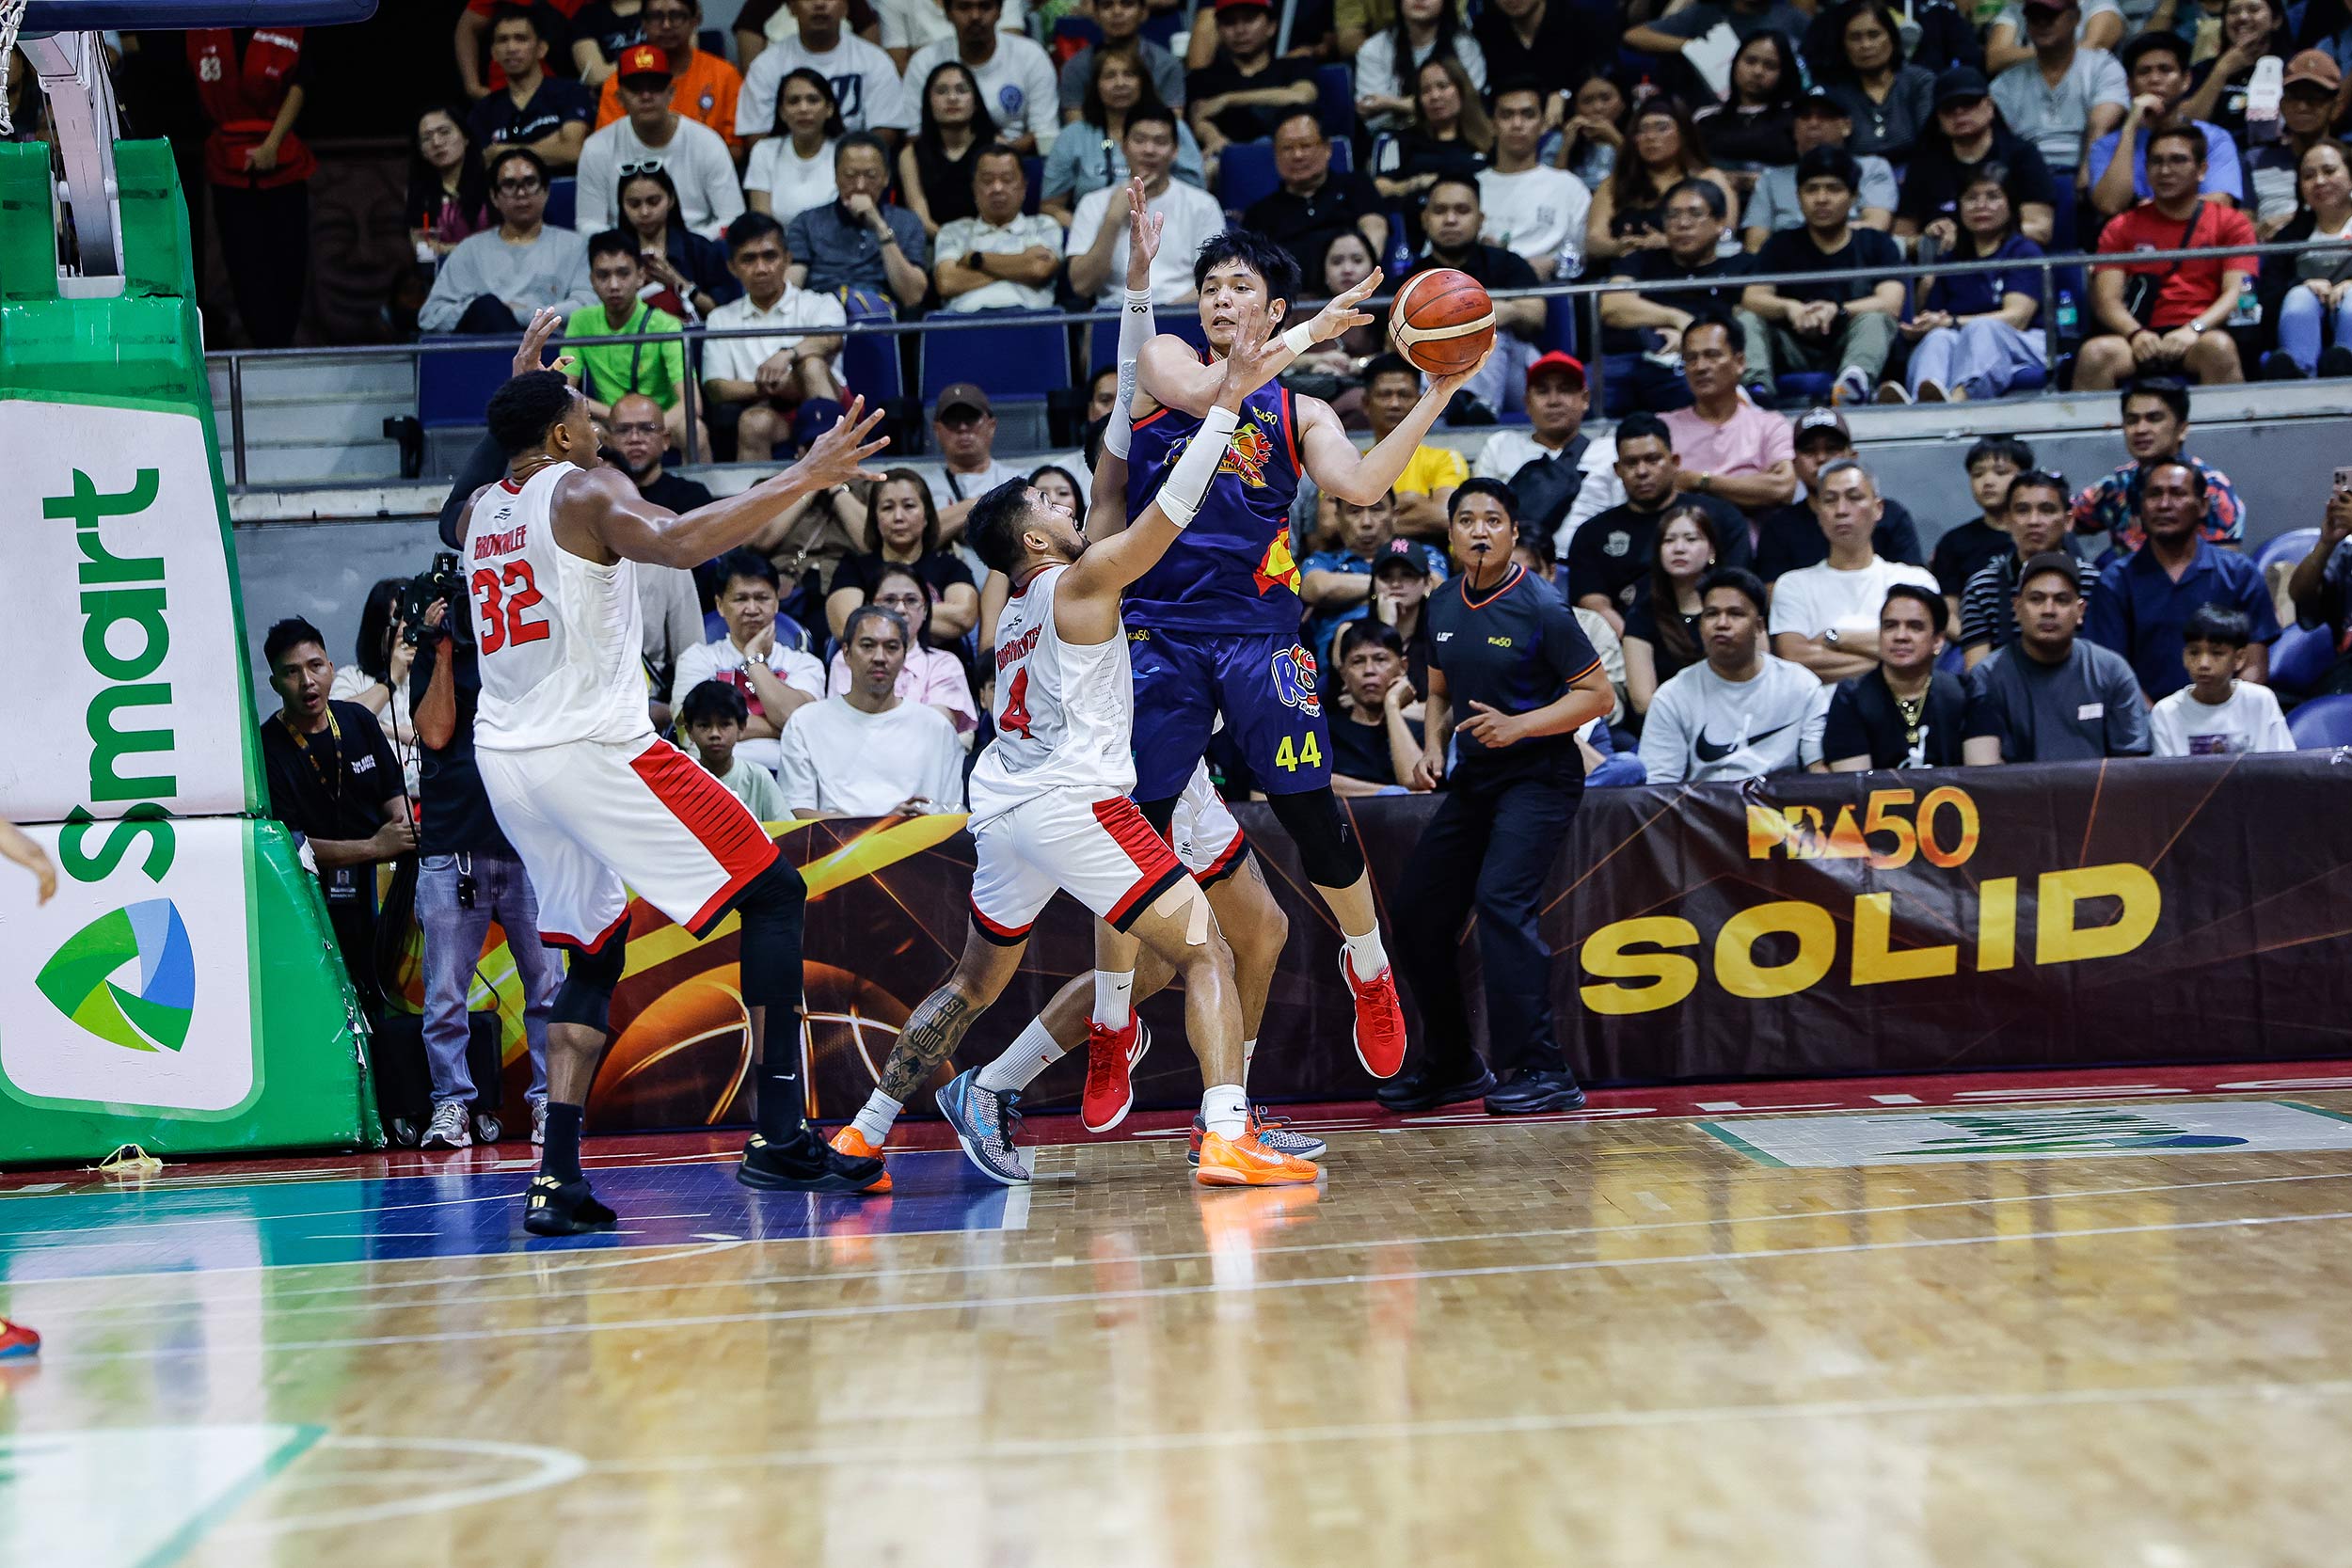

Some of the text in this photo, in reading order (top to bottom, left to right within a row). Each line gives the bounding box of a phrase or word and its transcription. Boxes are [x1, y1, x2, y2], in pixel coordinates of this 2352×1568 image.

[474, 524, 527, 561] BROWNLEE
[472, 559, 550, 656] 32
[42, 467, 177, 884] Smart
[999, 665, 1035, 740] 4
[1276, 731, 1322, 772] 44
[1746, 785, 1979, 870] PBA50
[1580, 862, 2162, 1016] SOLID
[914, 1024, 942, 1051] QUIT
